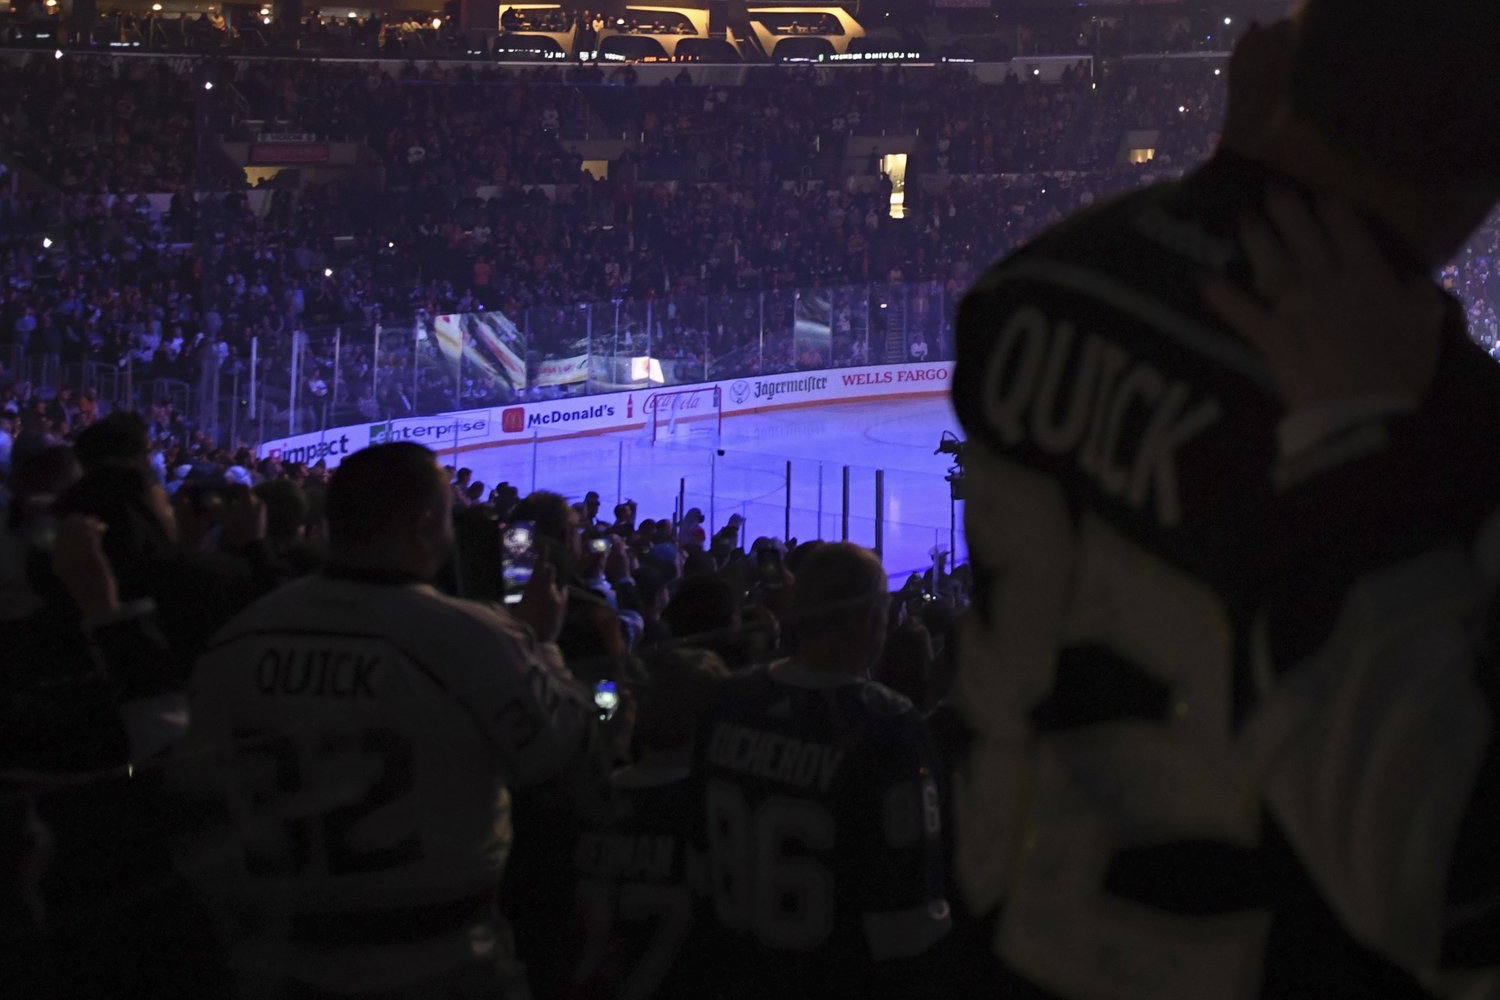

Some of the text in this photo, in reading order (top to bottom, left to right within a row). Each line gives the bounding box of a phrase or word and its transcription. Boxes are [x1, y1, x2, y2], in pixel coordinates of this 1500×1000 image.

[754, 377, 828, 400] Jägermeister
[842, 368, 948, 387] WELLS FARGO
[527, 404, 614, 429] McDonald's
[985, 304, 1220, 528] QUICK
[281, 434, 349, 464] impact
[255, 648, 382, 699] QUICK
[705, 778, 836, 951] 86
